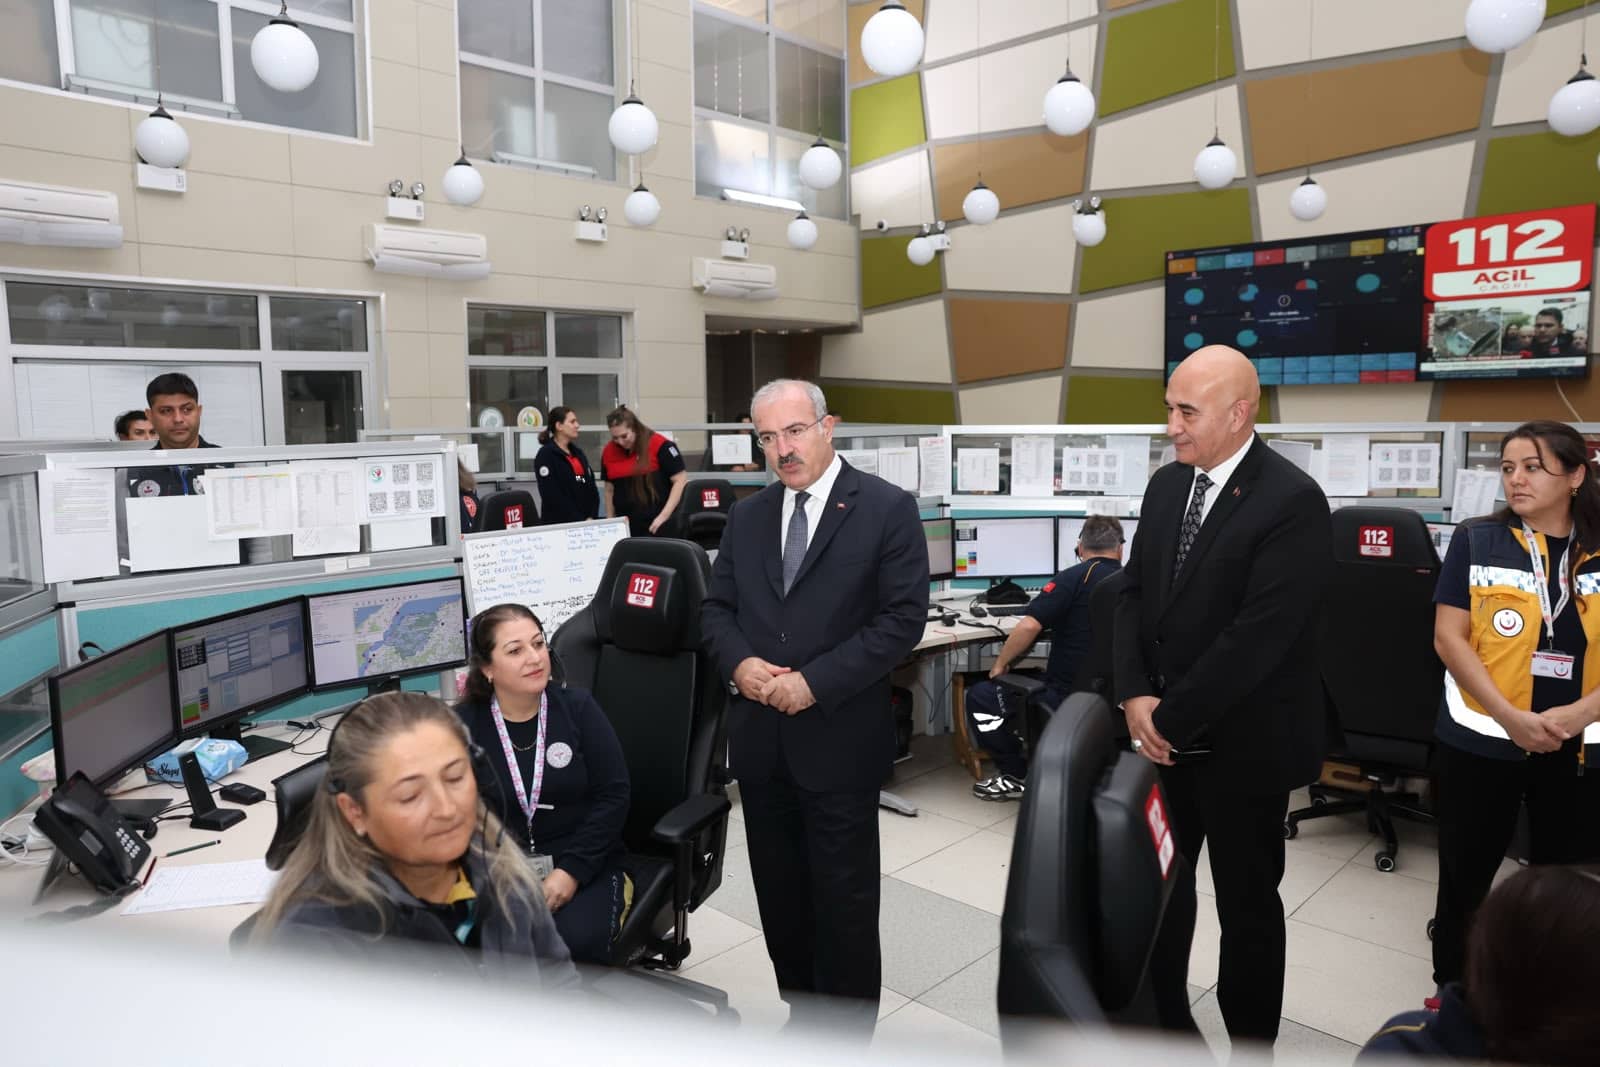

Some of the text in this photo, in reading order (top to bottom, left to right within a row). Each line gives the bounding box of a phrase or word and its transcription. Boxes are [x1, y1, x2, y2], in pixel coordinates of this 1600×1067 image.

[1449, 219, 1565, 266] 112
[704, 491, 717, 500] 112
[507, 508, 520, 522] 112
[1364, 530, 1388, 544] 112
[634, 577, 654, 594] 112
